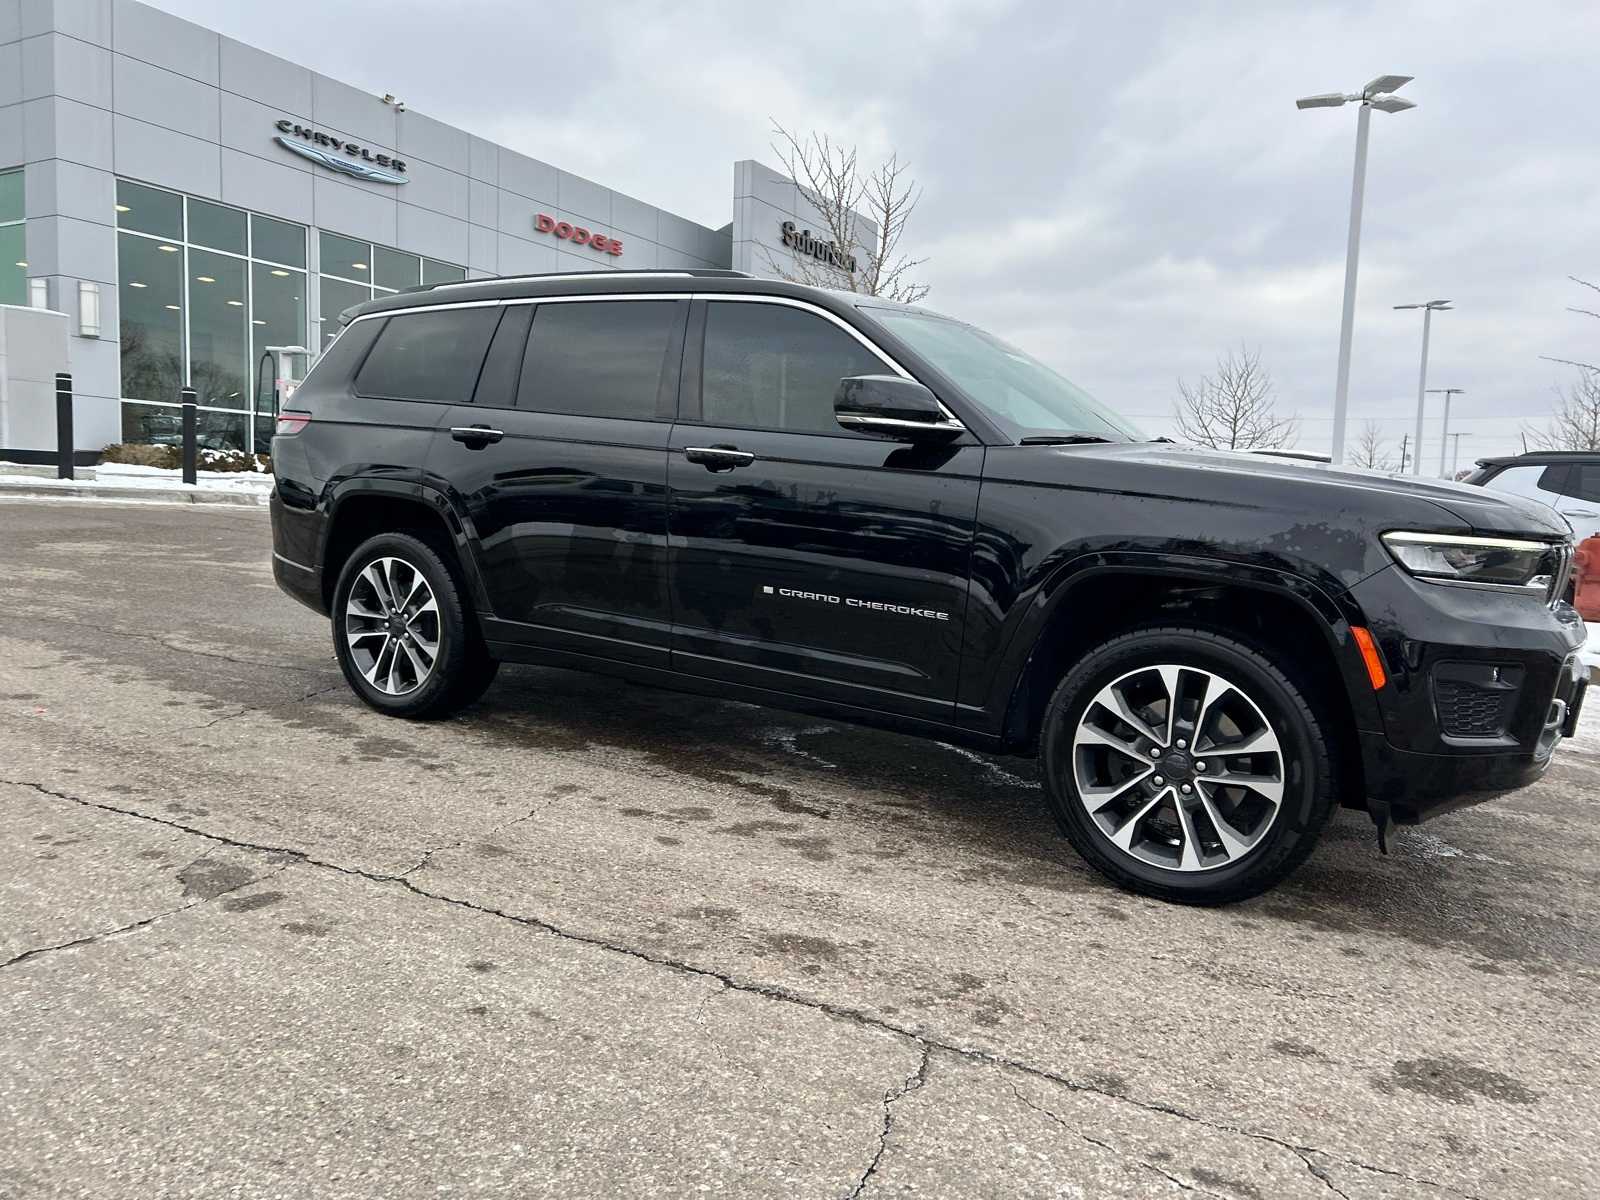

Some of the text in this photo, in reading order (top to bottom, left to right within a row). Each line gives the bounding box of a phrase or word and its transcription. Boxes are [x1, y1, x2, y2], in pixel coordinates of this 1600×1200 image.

[275, 119, 406, 173] CHRYSLER
[534, 213, 623, 257] DODGE
[779, 588, 949, 621] GRAND CHEROKEE
